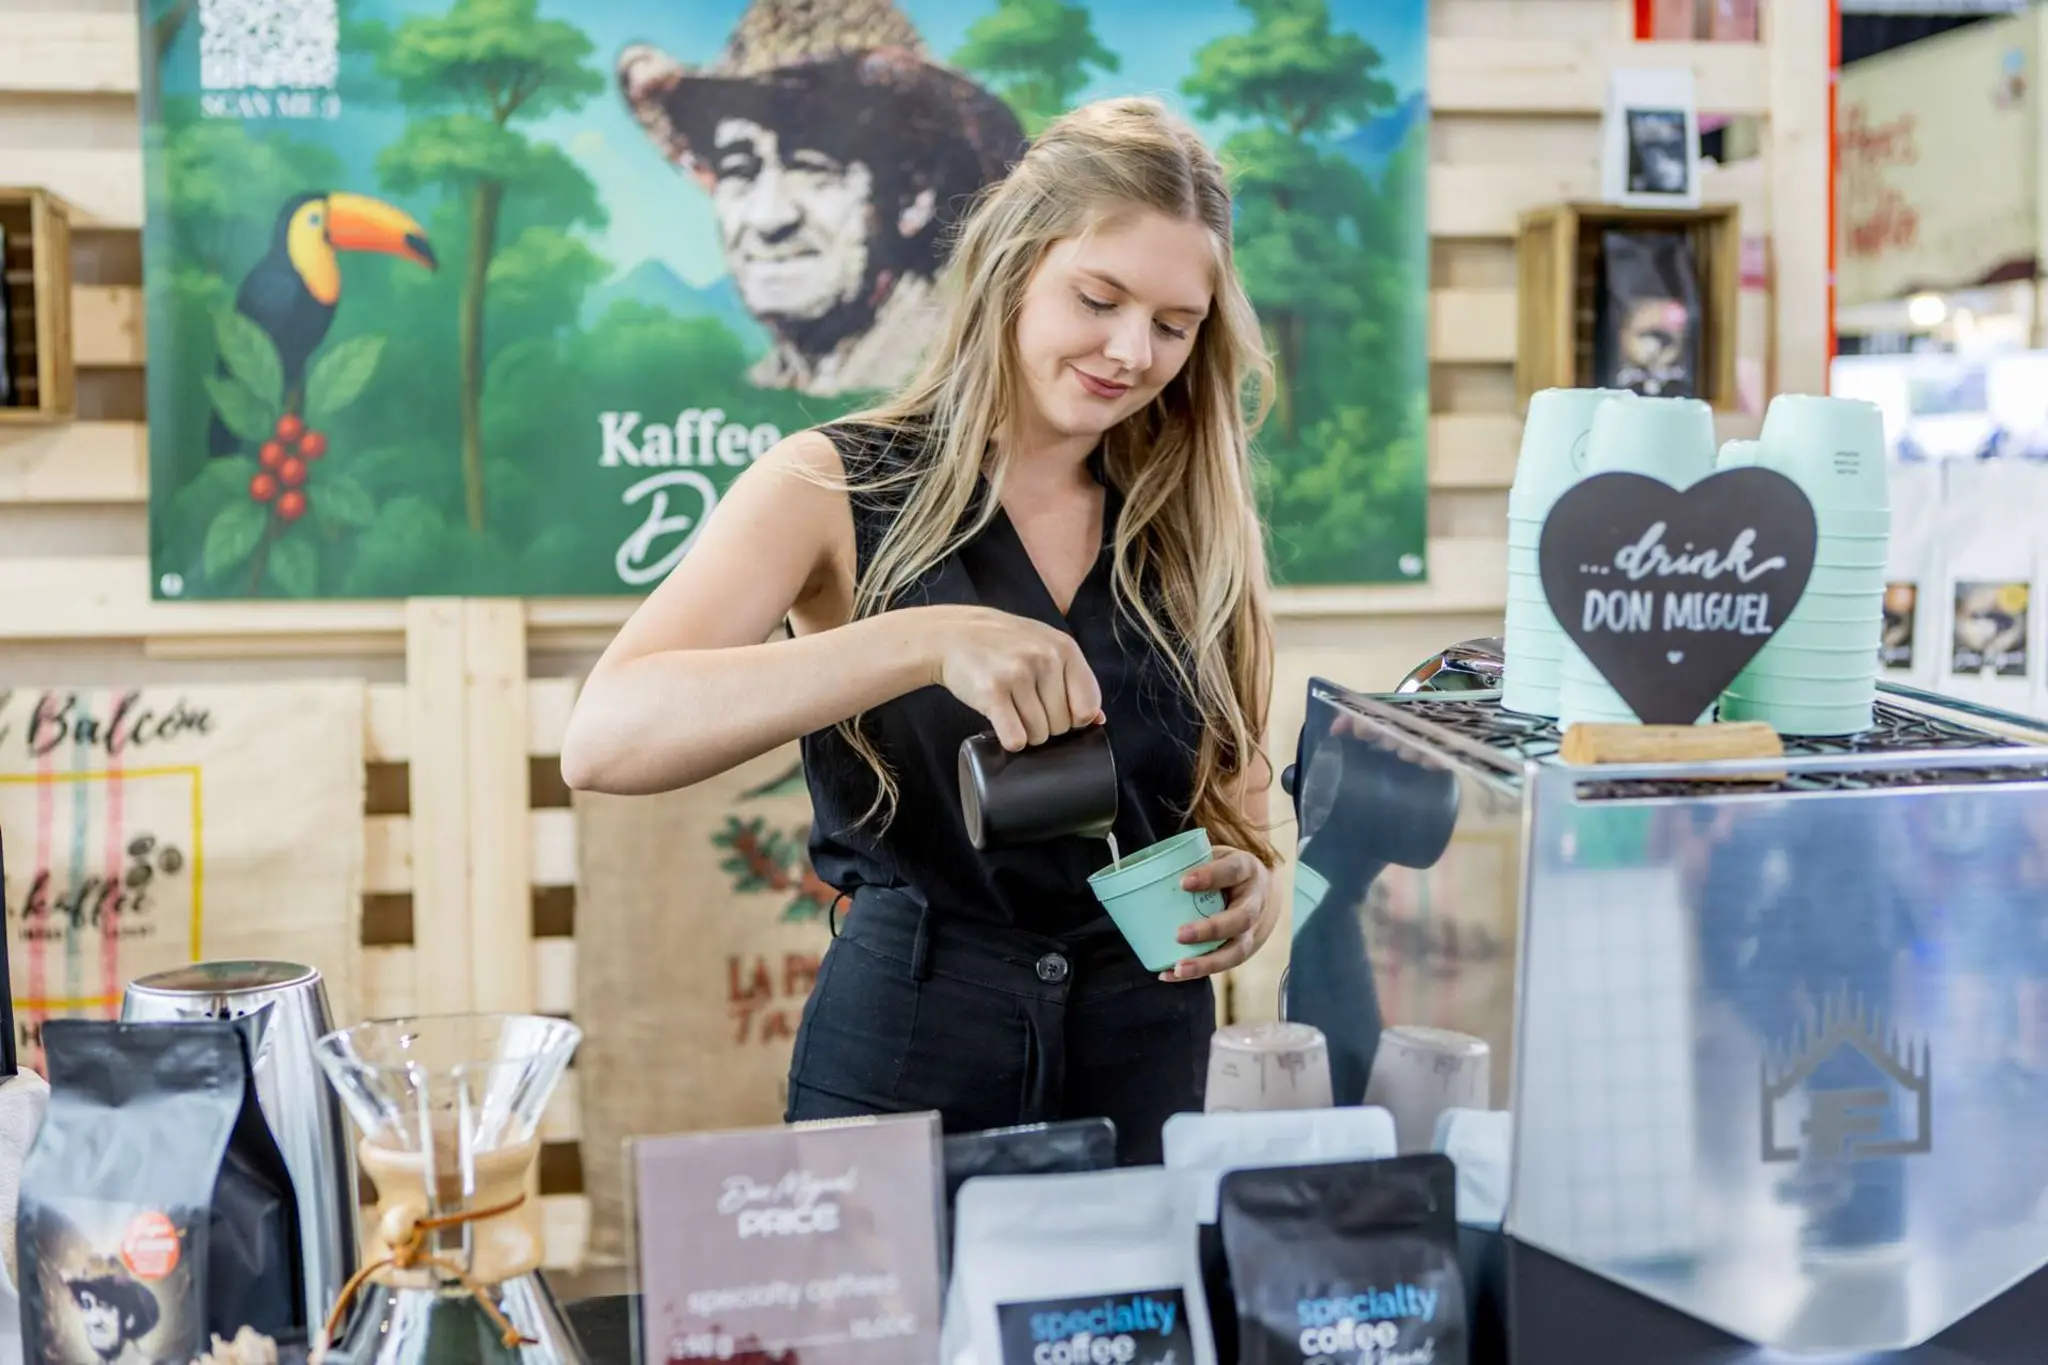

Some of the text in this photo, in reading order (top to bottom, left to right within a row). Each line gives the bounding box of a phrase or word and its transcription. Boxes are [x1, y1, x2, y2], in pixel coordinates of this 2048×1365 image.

[200, 91, 272, 119] SCAN
[275, 91, 319, 119] ME
[597, 407, 782, 467] Kaffee
[615, 469, 720, 585] D
[1582, 588, 1773, 635] DON MIGUEL
[727, 954, 773, 1003] LA
[737, 1203, 839, 1239] PRICE
[1030, 1296, 1176, 1342] specialty
[1297, 1282, 1438, 1327] specialty
[1033, 1332, 1137, 1365] coffee
[1299, 1317, 1399, 1356] coffee
